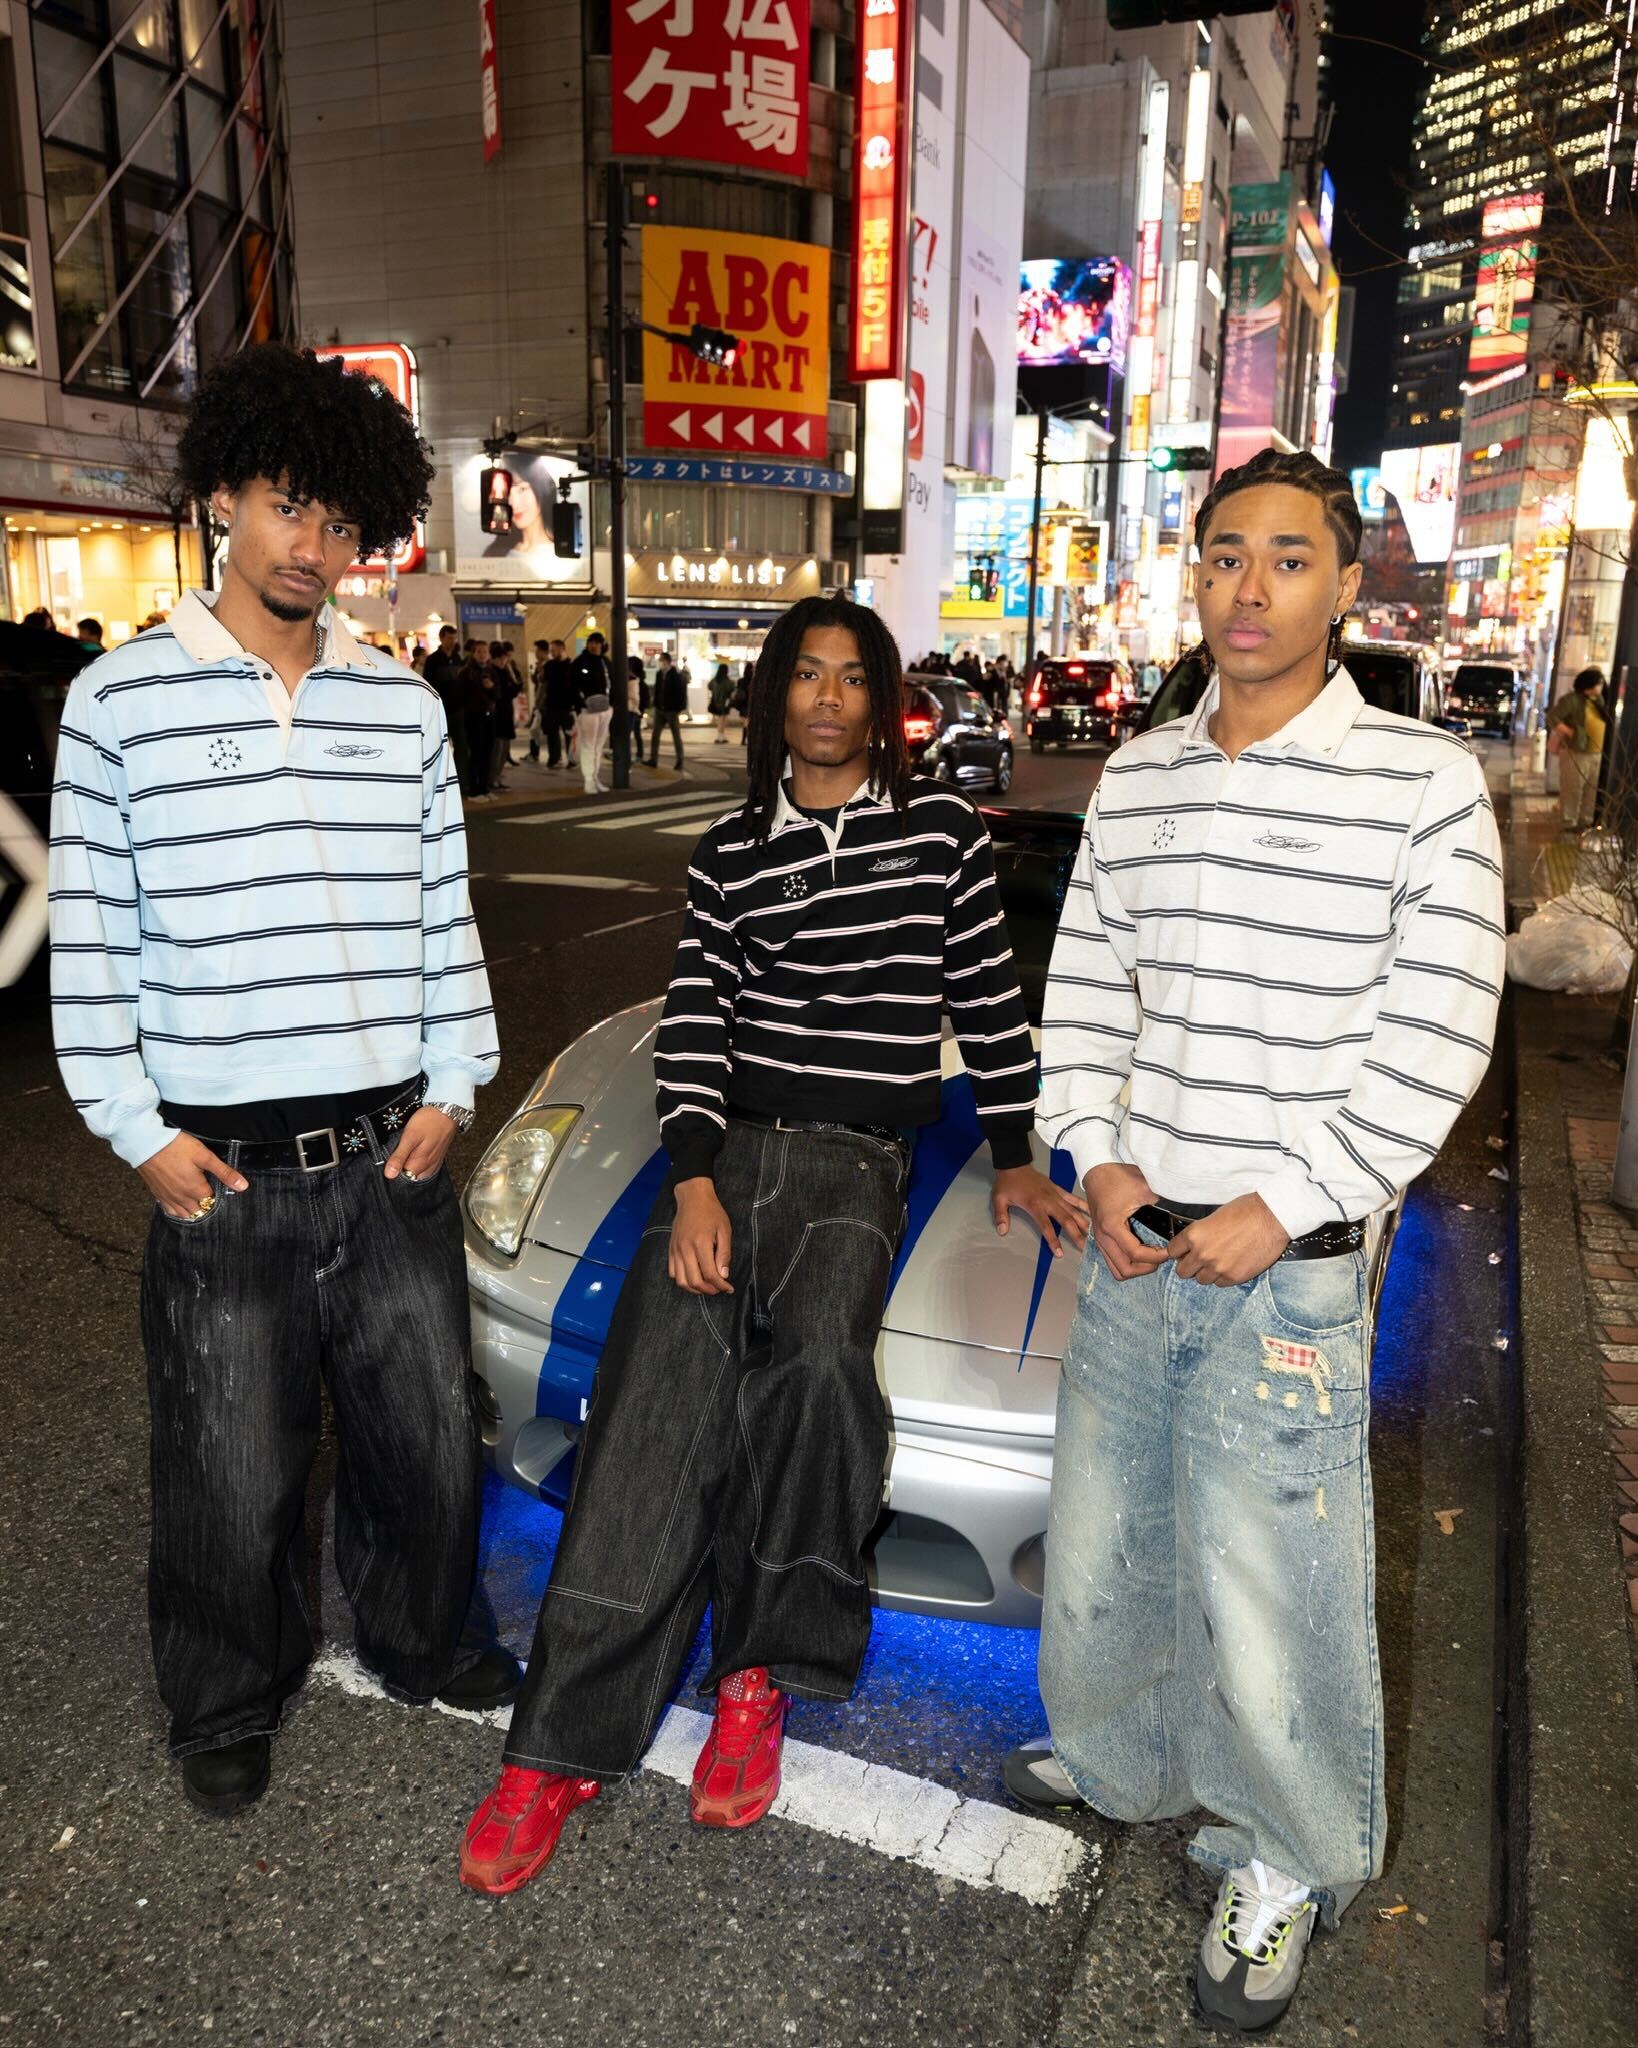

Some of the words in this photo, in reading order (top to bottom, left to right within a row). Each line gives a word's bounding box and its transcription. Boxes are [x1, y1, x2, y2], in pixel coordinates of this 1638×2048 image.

[668, 249, 810, 338] ABC
[626, 460, 846, 491] ンタクトはレンズリスト
[657, 561, 721, 583] LENS
